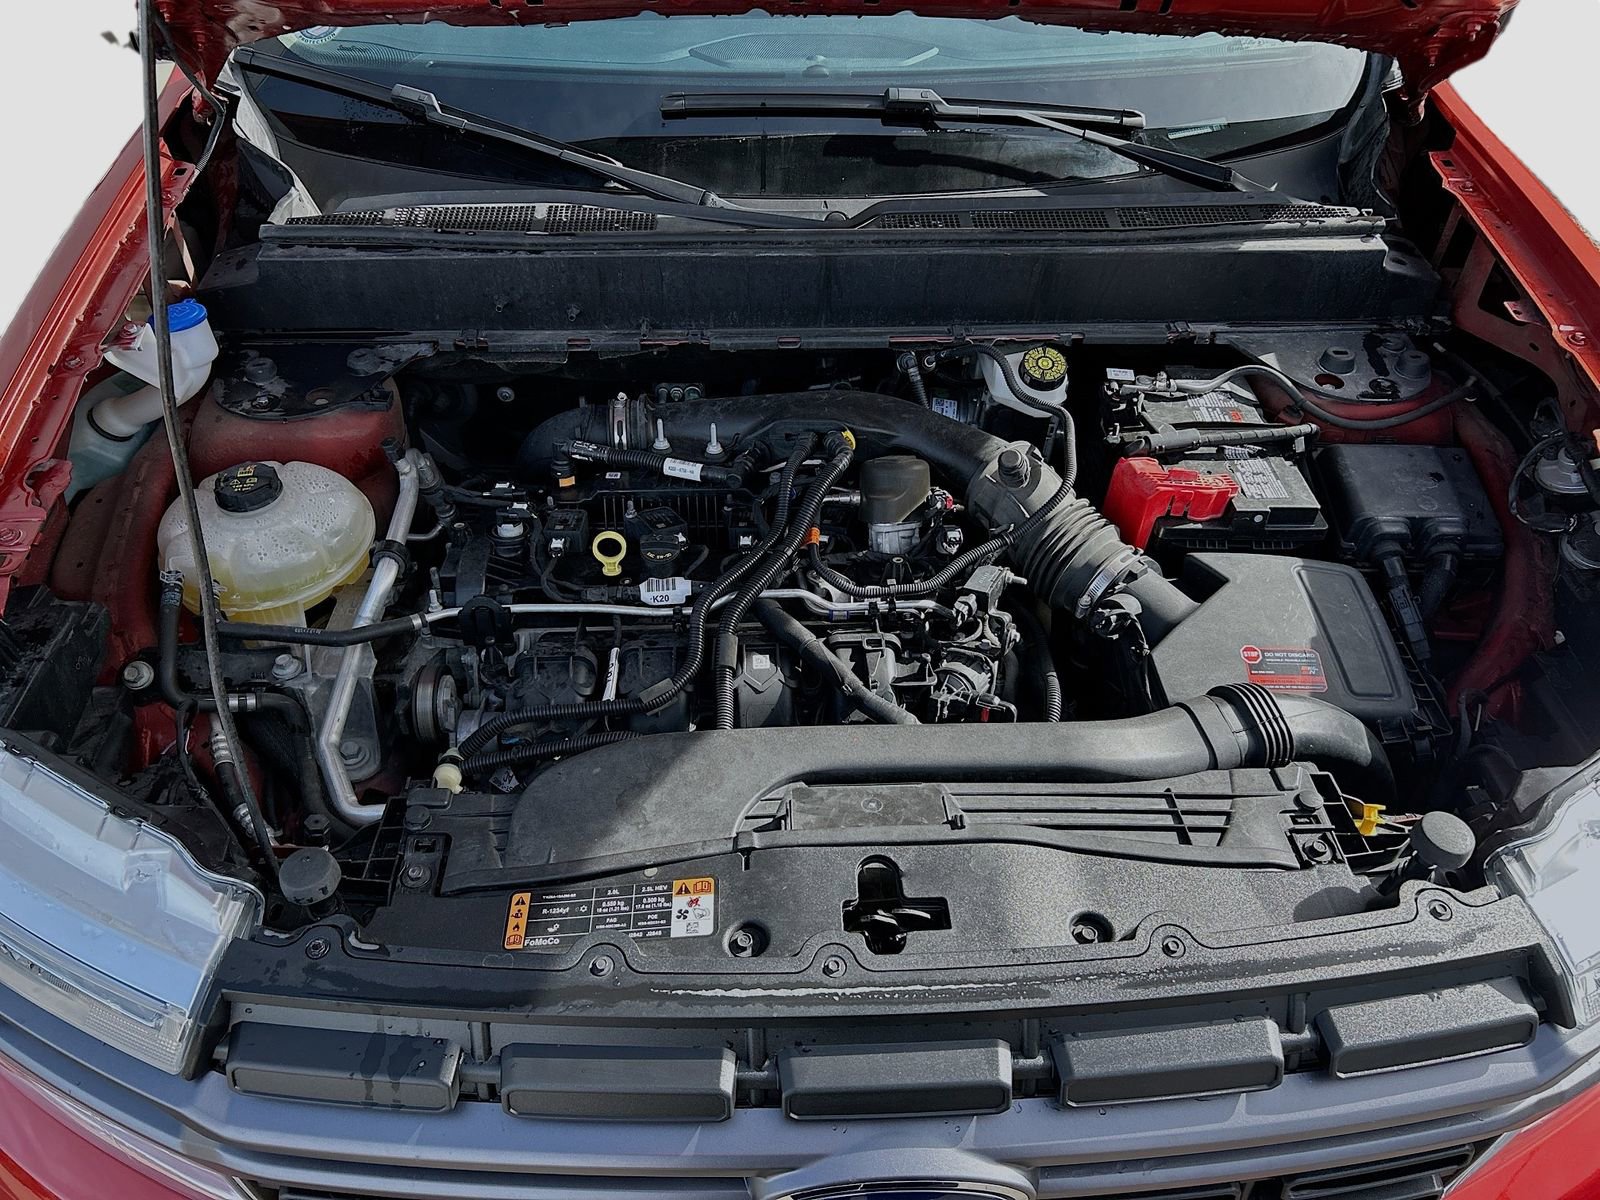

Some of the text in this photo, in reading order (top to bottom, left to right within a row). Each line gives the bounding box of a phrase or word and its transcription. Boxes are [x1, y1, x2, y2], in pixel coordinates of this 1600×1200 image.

[299, 33, 336, 44] PROTECTION
[542, 907, 569, 915] R-1234yf
[524, 937, 560, 947] FoMoCo
